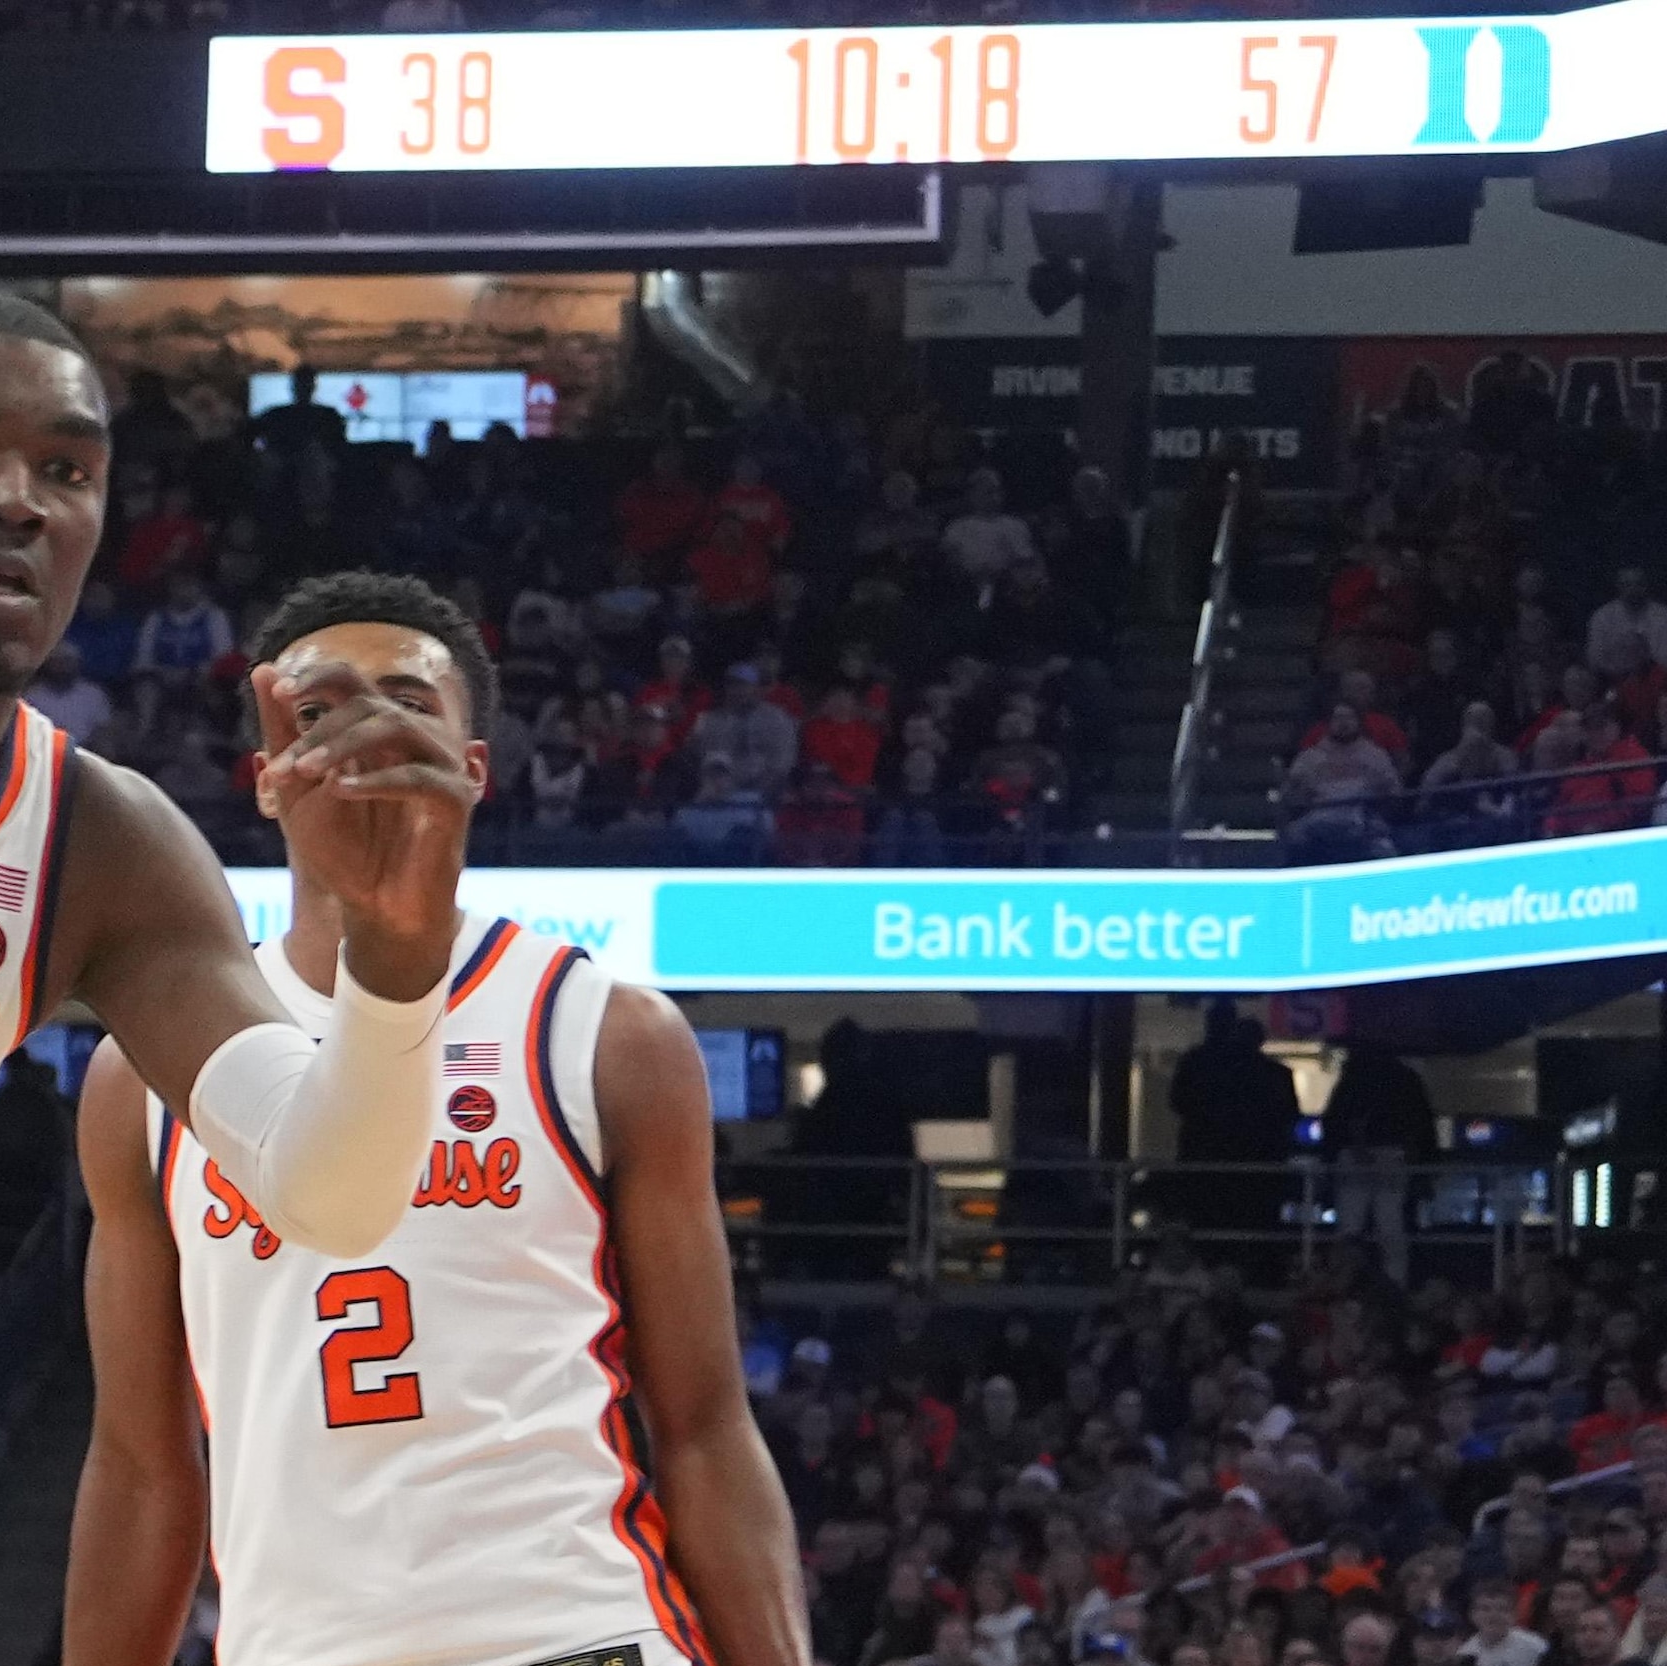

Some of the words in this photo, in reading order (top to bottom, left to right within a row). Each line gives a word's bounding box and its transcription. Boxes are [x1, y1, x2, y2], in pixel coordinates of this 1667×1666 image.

[262, 47, 346, 171] S
[400, 51, 492, 155] 38
[786, 34, 1021, 165] 10:18
[1238, 35, 1338, 146] 57
[873, 900, 1033, 960] Bank
[1053, 900, 1256, 960] better
[1349, 881, 1639, 944] broadviewfcu.com
[315, 1265, 424, 1429] 2
